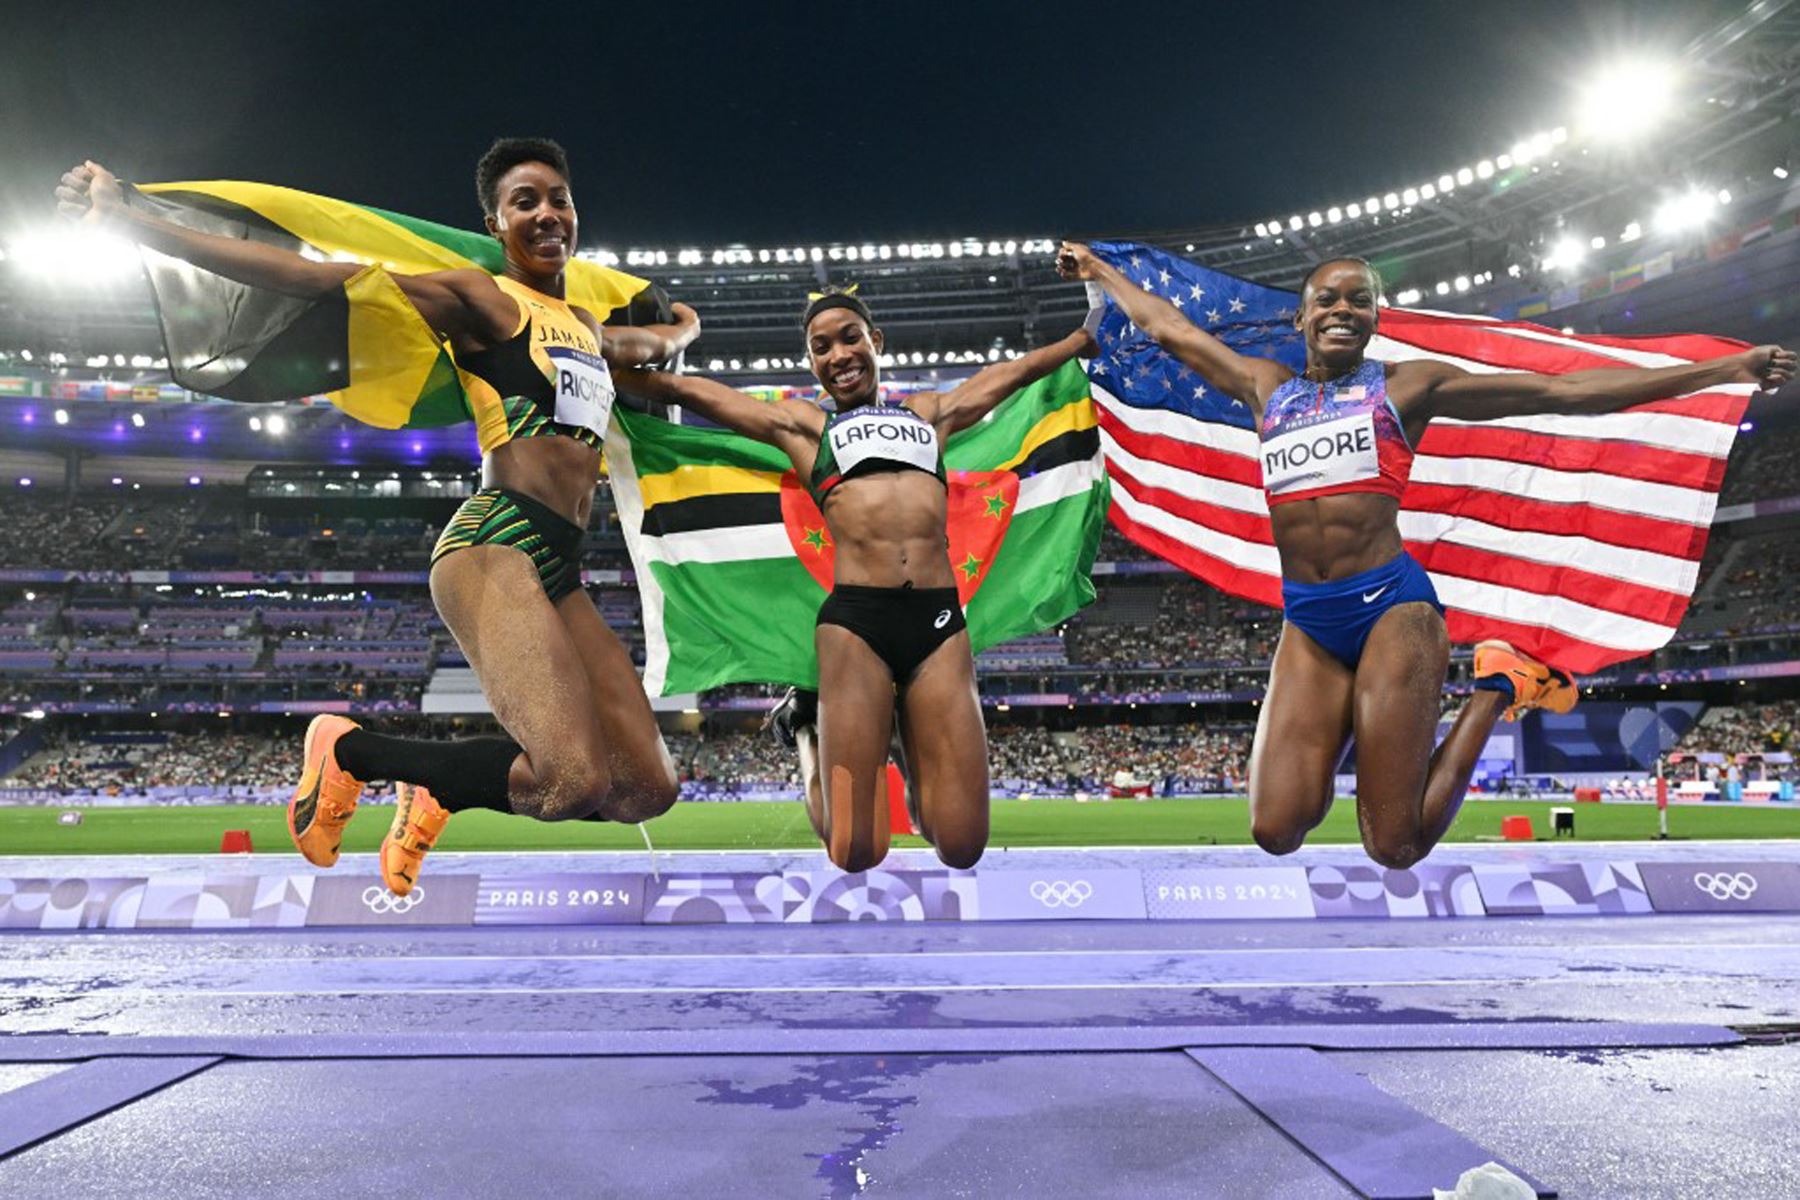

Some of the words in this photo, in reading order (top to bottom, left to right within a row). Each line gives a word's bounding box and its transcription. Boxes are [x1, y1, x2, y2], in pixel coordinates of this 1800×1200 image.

[834, 423, 932, 450] LAFOND
[1266, 427, 1371, 475] MOORE
[489, 890, 559, 907] PARIS
[567, 889, 630, 906] 2024
[1157, 885, 1227, 901] PARIS
[1234, 884, 1297, 900] 2024
